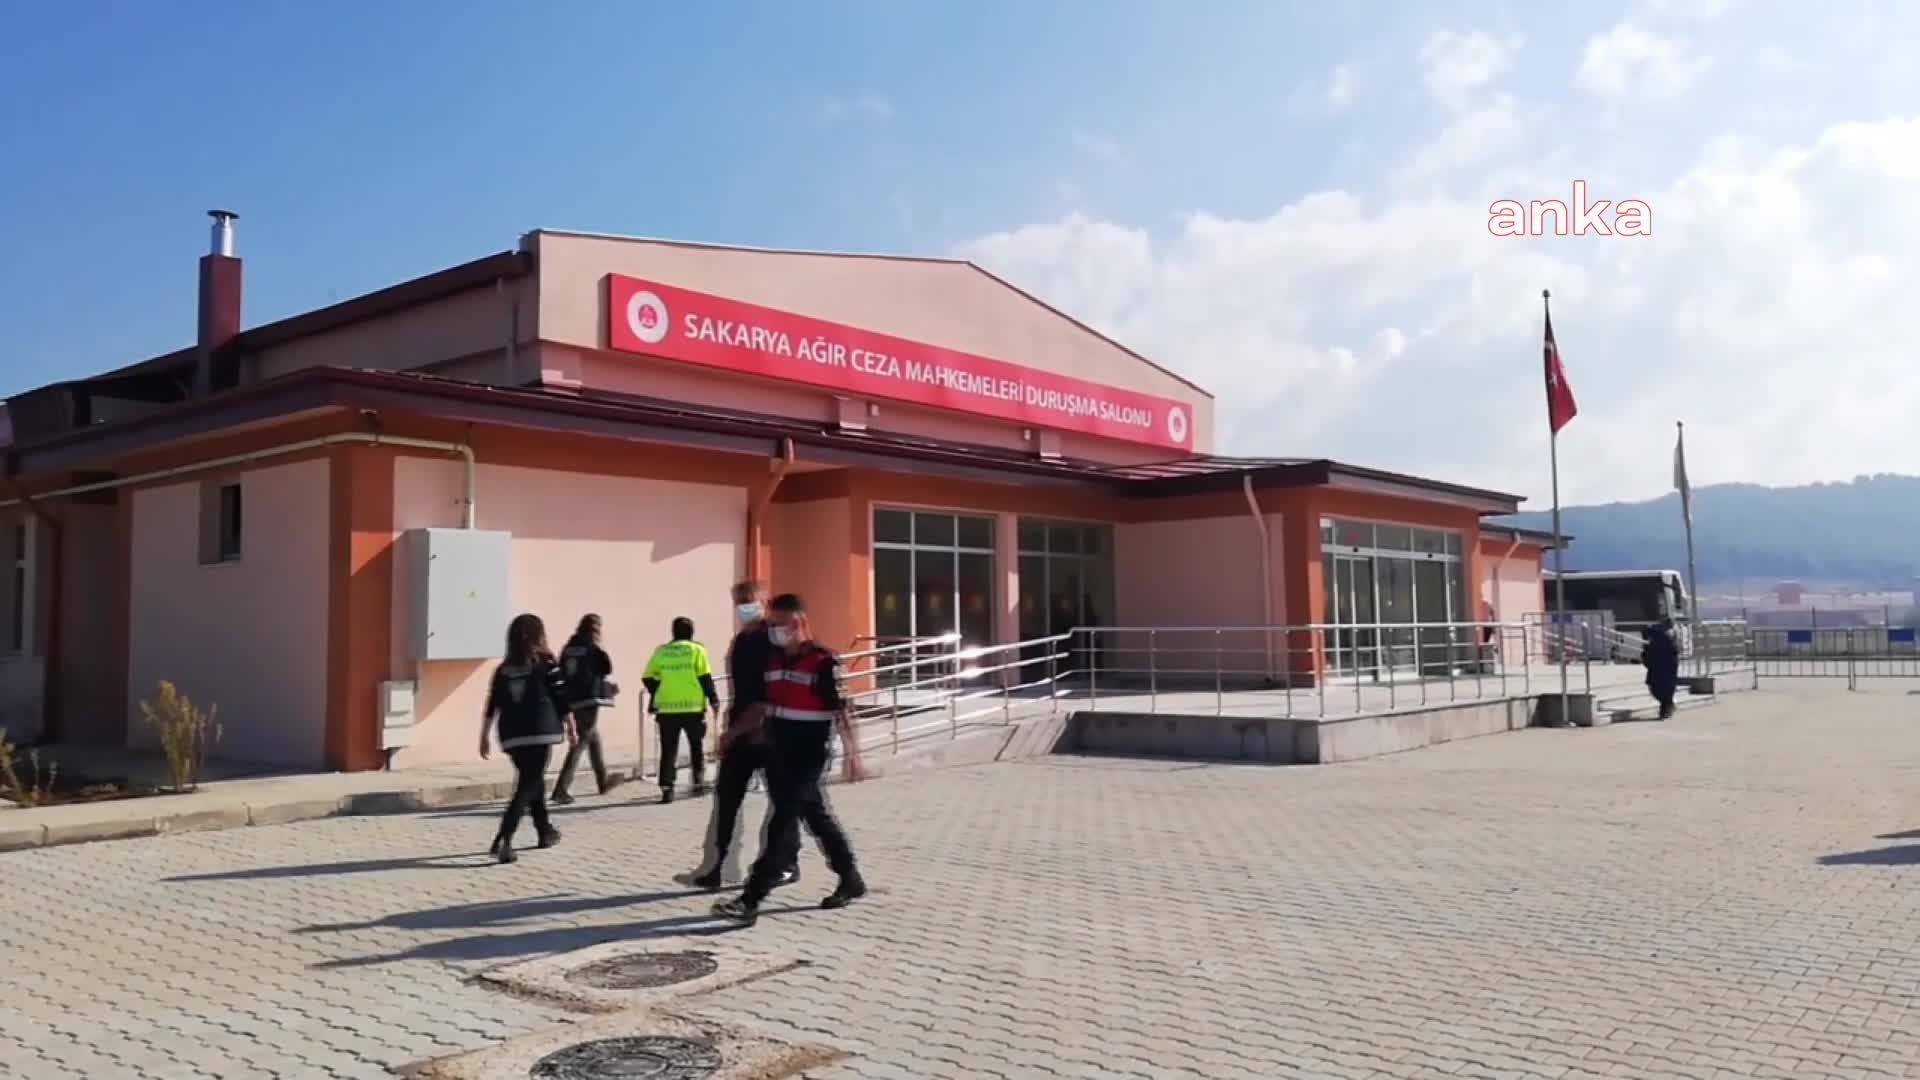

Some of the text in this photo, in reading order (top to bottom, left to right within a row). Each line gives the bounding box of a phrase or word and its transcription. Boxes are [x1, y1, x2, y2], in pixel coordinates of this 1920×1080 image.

[684, 314, 1152, 427] SAKARYA AĞIR CEZA MAHKEMELERİ DURUŞMA SALONU
